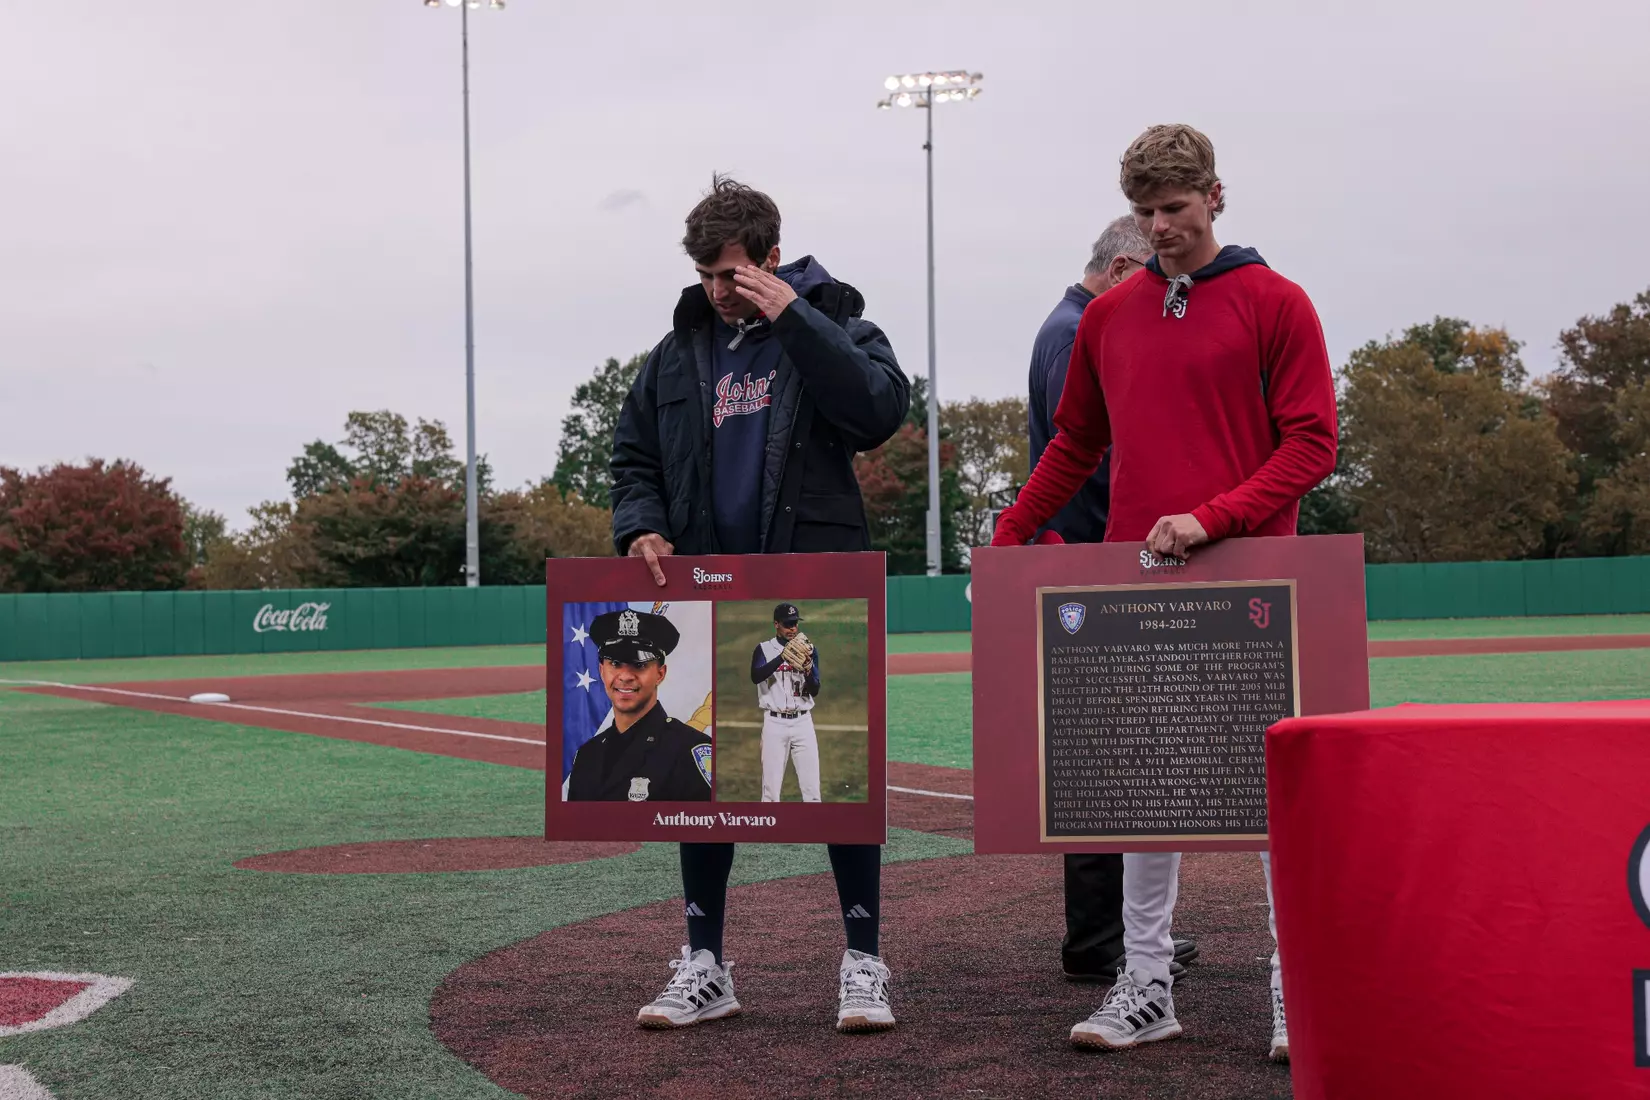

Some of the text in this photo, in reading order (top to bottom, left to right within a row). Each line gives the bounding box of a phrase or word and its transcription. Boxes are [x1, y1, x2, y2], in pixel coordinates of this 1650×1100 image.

[714, 401, 765, 416] BASEBALL
[1100, 600, 1232, 614] ANTHONY VARVARO
[253, 602, 331, 632] Coca-Cola
[1138, 618, 1197, 630] 1984-2022
[1051, 646, 1100, 654] ANTHONY
[1104, 644, 1150, 653] VARVARO
[1178, 643, 1208, 651] MUCH
[1212, 642, 1240, 650] MORE
[1245, 641, 1273, 649] THAN
[1051, 656, 1097, 664] BASEBALL
[1146, 653, 1199, 662] STANDOUT
[1199, 653, 1241, 661] PITCHER
[1264, 651, 1284, 659] THE
[1074, 666, 1109, 674] STORM
[1113, 665, 1151, 673] DURING
[1155, 664, 1182, 672] SOME
[1204, 663, 1223, 671] THE
[1228, 661, 1285, 670] PROGRAM'S
[1052, 677, 1080, 685] MOST
[1085, 675, 1148, 684] SUCCESSFUL
[1153, 674, 1201, 682] SEASONS,
[1206, 673, 1258, 681] VARVARO
[1052, 687, 1098, 695] SELECTED
[1101, 686, 1112, 694] IN
[1137, 685, 1161, 693] 12TH
[1164, 684, 1199, 692] ROUND
[1265, 682, 1285, 690] MLB
[1052, 697, 1082, 705] DRAFT
[1086, 696, 1122, 704] BEFORE
[1126, 695, 1173, 704] SPENDING
[1195, 694, 1225, 702] YEARS
[1242, 693, 1261, 701] THE
[1052, 707, 1079, 715] FROM
[1083, 707, 1119, 715] 2010-15.
[1122, 706, 1148, 714] UPON
[1152, 705, 1198, 713] RETIRING
[1200, 704, 1229, 712] FROM
[1254, 703, 1286, 712] GAME,
[1101, 717, 1146, 725] ENTERED
[1149, 716, 1168, 724] THE
[1171, 715, 1219, 723] ACADEMY
[1053, 728, 1112, 736] AUTHORITY
[1117, 727, 1151, 735] POLICE
[1156, 725, 1227, 734] DEPARTMENT,
[1121, 736, 1183, 745] DISTINCTION
[1053, 748, 1093, 756] DECADE.
[1113, 747, 1137, 755] SEPT.
[1140, 747, 1152, 755] 11,
[1154, 747, 1177, 755] 2022,
[1180, 746, 1211, 754] WHILE
[1053, 758, 1115, 767] PARTICIPATE
[1146, 757, 1164, 765] 9/11
[1170, 757, 1224, 765] MEMORIAL
[1229, 756, 1266, 764] CEREM
[1054, 769, 1099, 777] VARVARO
[1102, 768, 1163, 776] TRAGICALLY
[1166, 767, 1190, 775] LOST
[1194, 767, 1209, 775] HIS
[1053, 780, 1070, 788] ON
[1070, 779, 1120, 787] COLLISION
[1158, 778, 1222, 786] WRONG-WAY
[1224, 777, 1260, 785] DRIVER
[1054, 790, 1072, 798] THE
[1077, 789, 1123, 797] HOLLAND
[1127, 789, 1169, 797] TUNNEL.
[1190, 788, 1211, 796] WAS
[1054, 800, 1085, 808] SPIRIT
[1146, 799, 1161, 807] HIS
[1164, 799, 1203, 807] FAMILY,
[1206, 798, 1222, 806] HIS
[1225, 798, 1268, 806] TEAMMA
[653, 811, 777, 829] Anthony Varvaro
[1071, 810, 1113, 819] FRIENDS,
[1131, 810, 1194, 818] COMMUNITY
[1054, 821, 1101, 829] PROGRAM
[1132, 820, 1177, 828] PROUDLY
[1180, 819, 1221, 827] HONORS
[1225, 819, 1241, 827] HIS
[1245, 819, 1268, 827] LEGA
